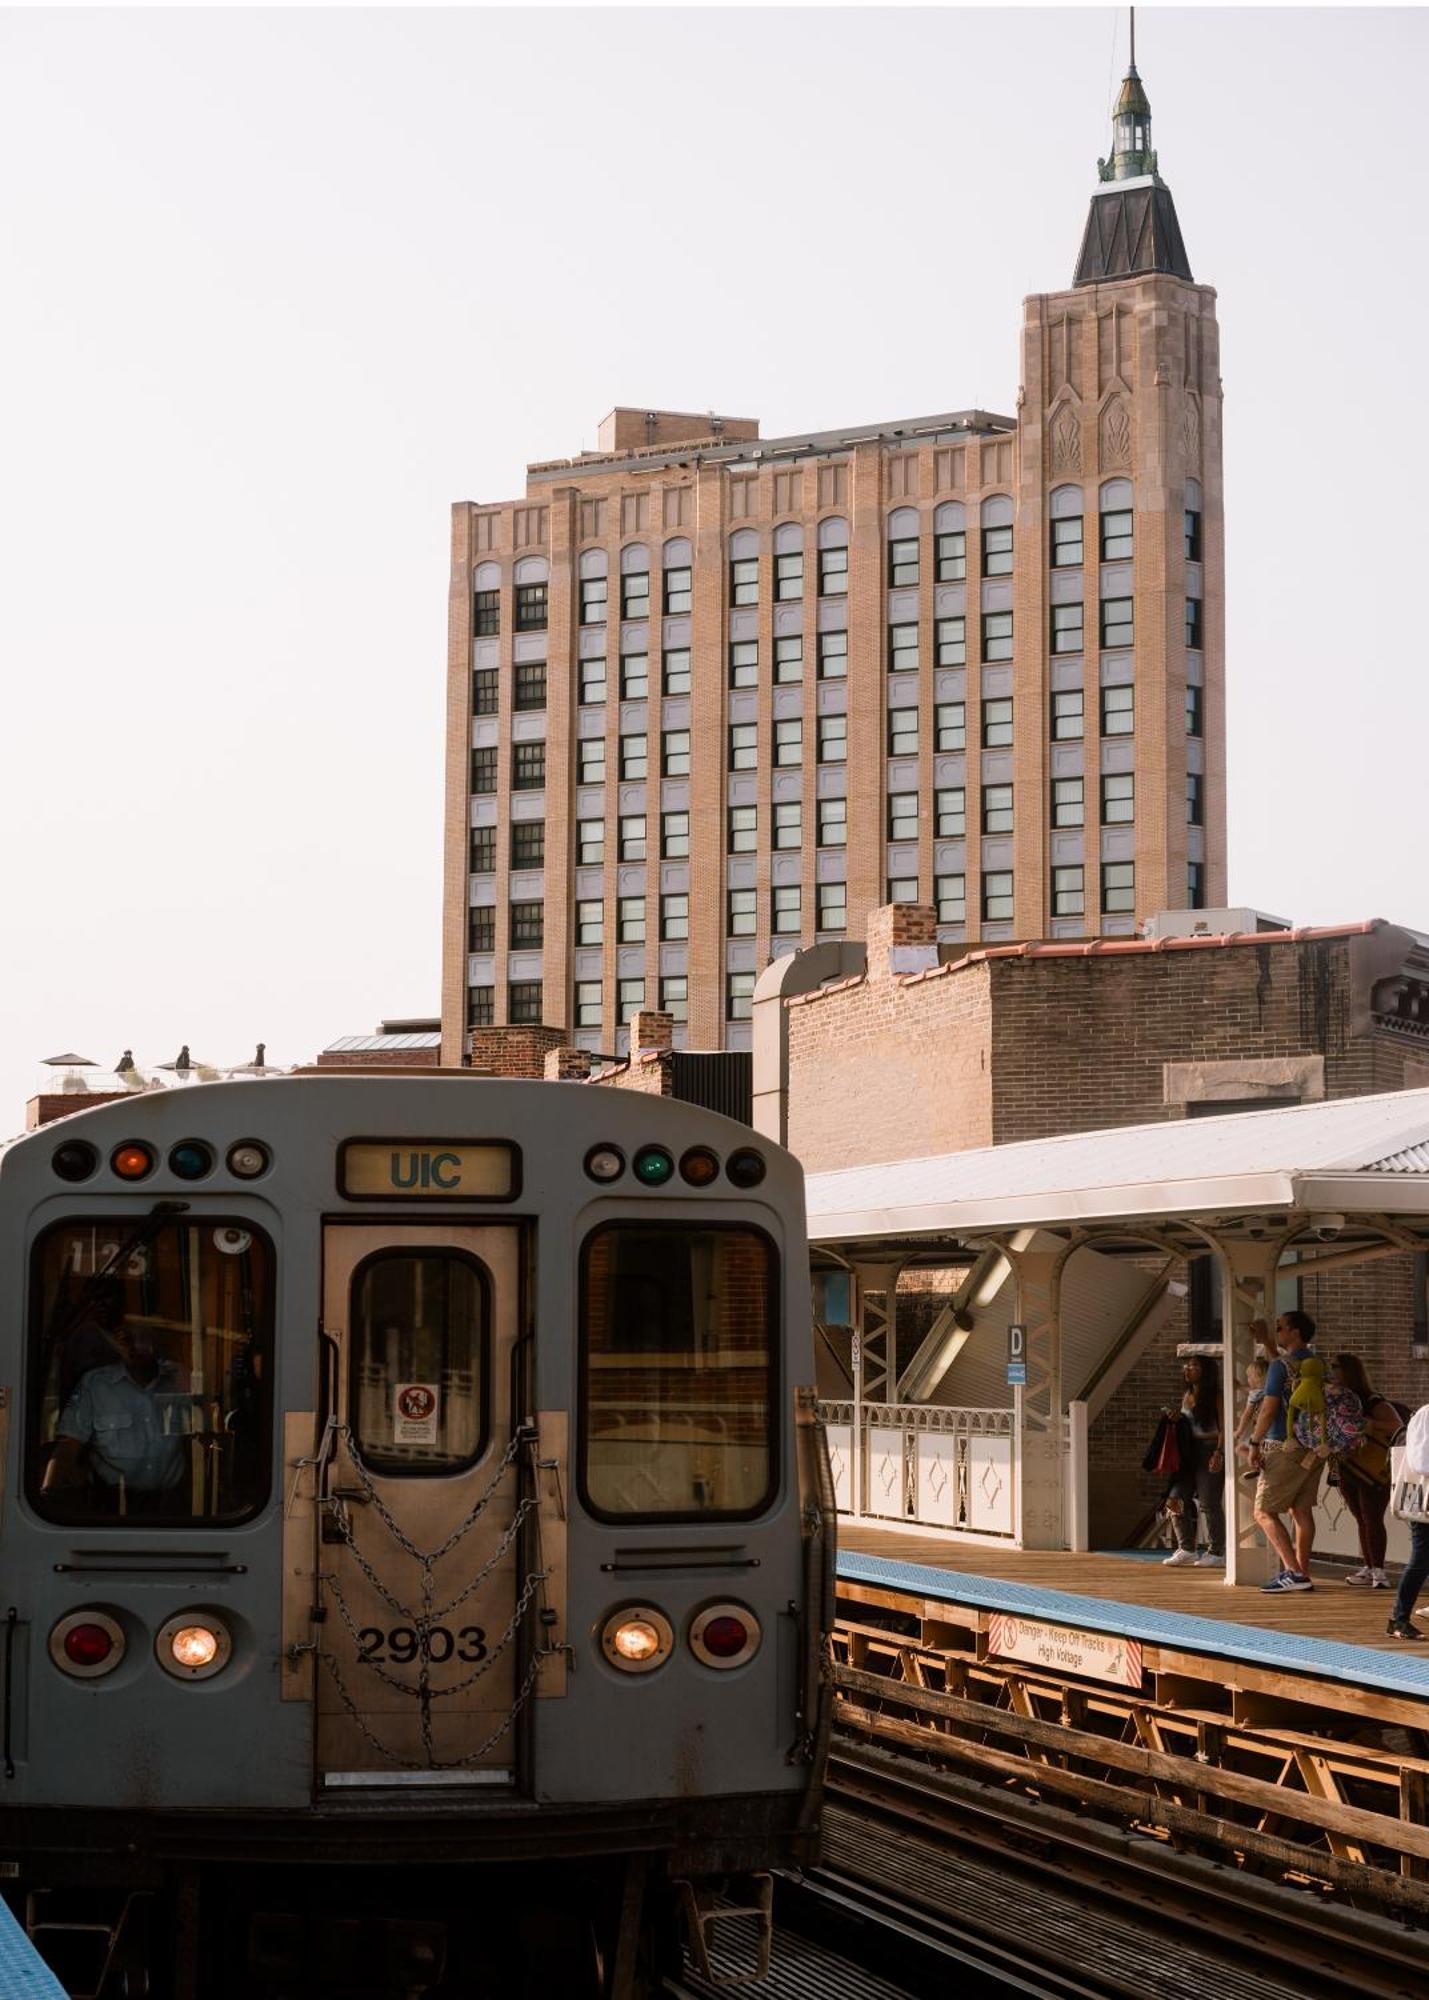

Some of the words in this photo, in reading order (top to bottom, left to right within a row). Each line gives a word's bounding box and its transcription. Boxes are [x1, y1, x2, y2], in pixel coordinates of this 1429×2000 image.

[391, 1152, 461, 1188] UIC
[1011, 1327, 1022, 1355] D
[357, 1626, 487, 1663] 2903
[1019, 1621, 1043, 1640] Danger
[1049, 1628, 1067, 1646] Keep
[1068, 1631, 1080, 1646] Off
[1081, 1634, 1105, 1652] Tracks
[1038, 1644, 1054, 1662] High
[1056, 1647, 1083, 1668] Voltage
